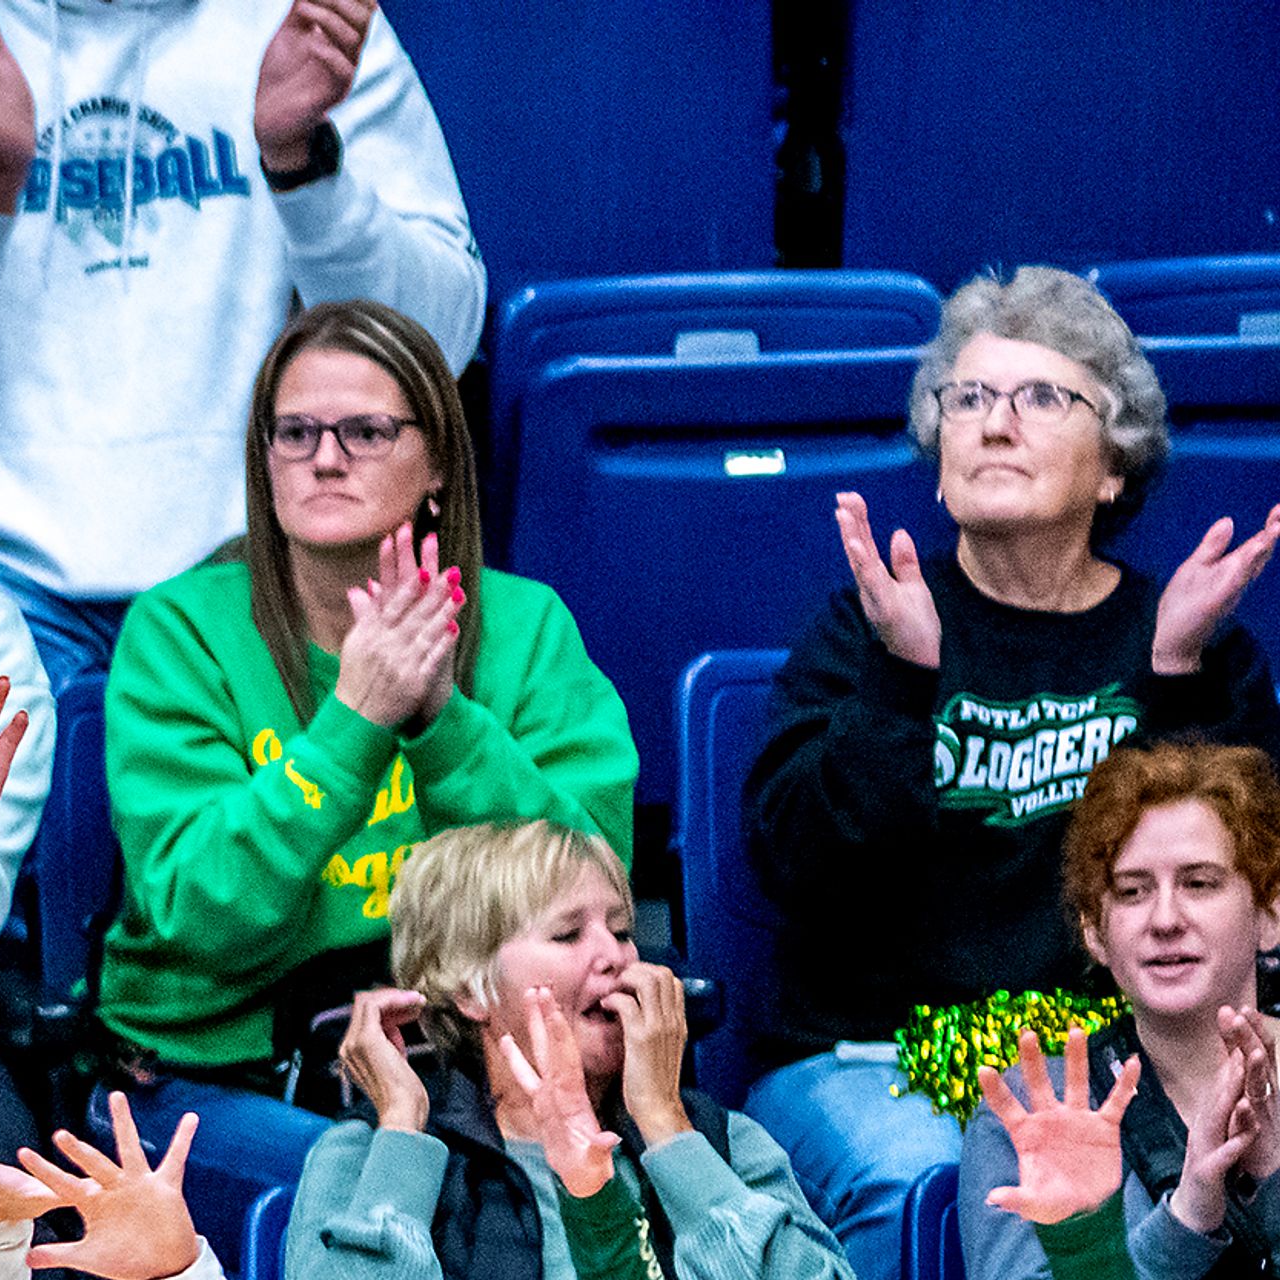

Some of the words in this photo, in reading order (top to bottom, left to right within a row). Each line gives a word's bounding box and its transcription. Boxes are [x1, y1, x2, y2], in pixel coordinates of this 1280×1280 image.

[21, 125, 251, 224] ASEBALL
[959, 695, 1098, 731] POTLATCH
[1010, 776, 1089, 819] VOLLEY
